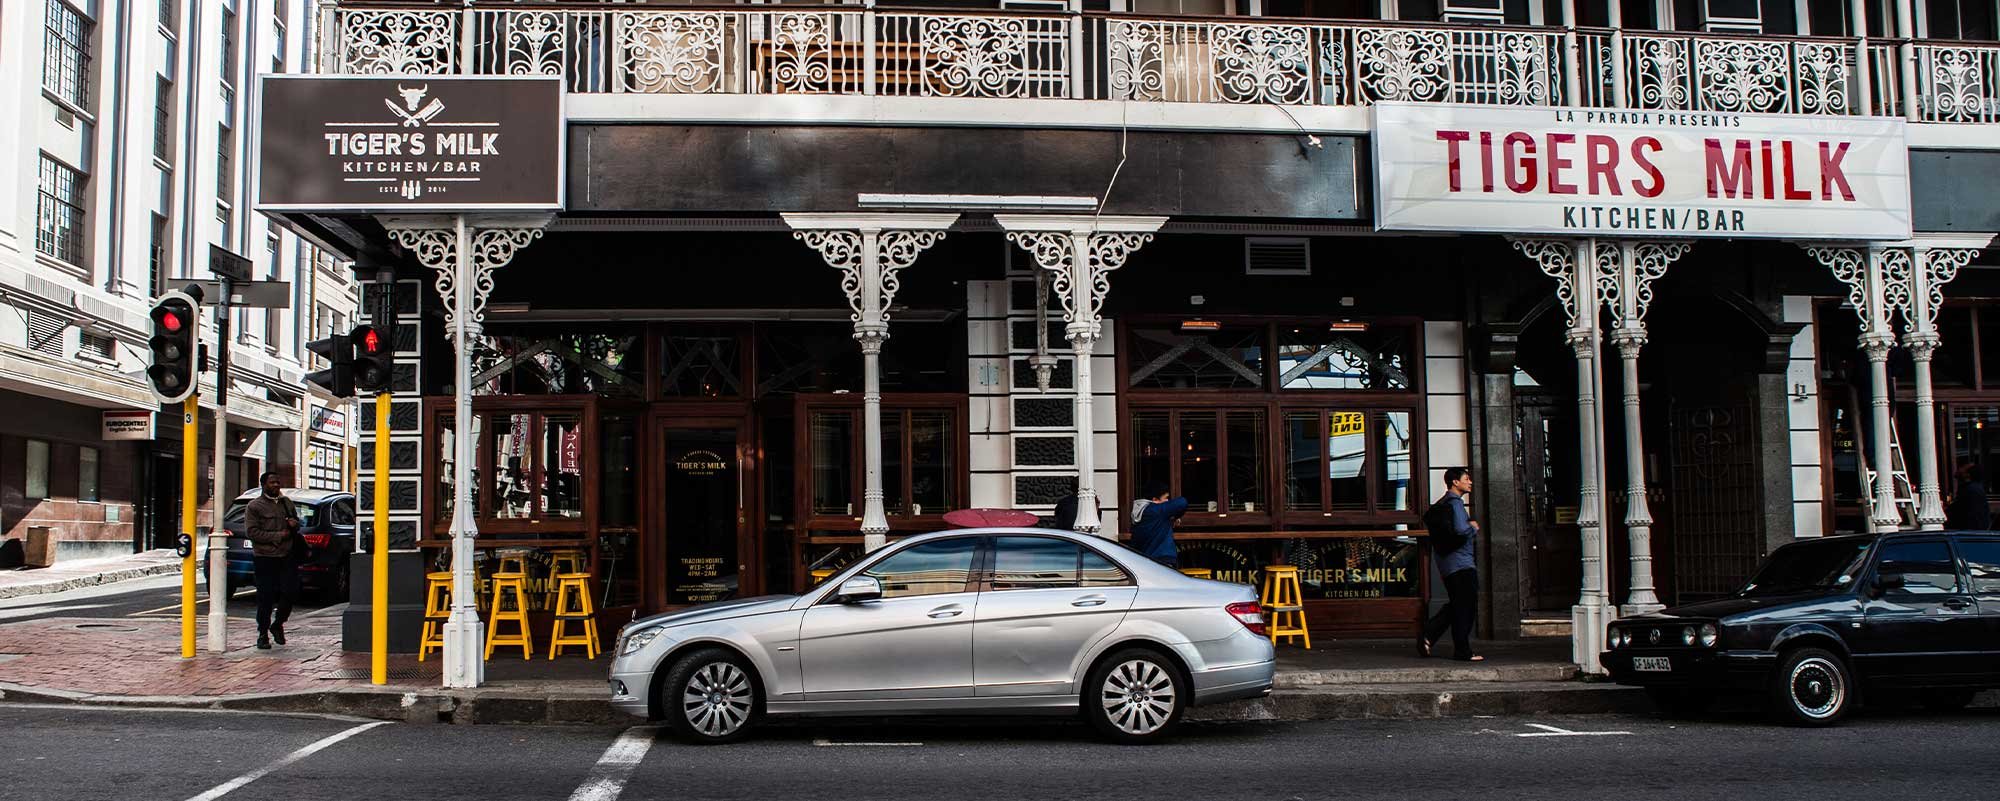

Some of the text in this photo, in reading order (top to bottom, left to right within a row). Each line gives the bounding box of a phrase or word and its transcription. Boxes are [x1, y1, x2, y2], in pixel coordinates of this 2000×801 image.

[1556, 111, 1740, 127] LA PARADA PRESENTS
[325, 133, 499, 155] TIGER'S MILK
[343, 161, 481, 172] KITCHEN/BAR
[1436, 130, 1857, 202] TIGERS MILK
[1563, 206, 1745, 231] KITCHEN/BAR
[185, 413, 191, 423] 3
[676, 461, 726, 470] TIGER'S MILK
[1216, 569, 1260, 584] MILK
[1366, 567, 1408, 583] MILK
[527, 578, 562, 593] MIL
[1325, 590, 1381, 599] KITCHEN/BAR
